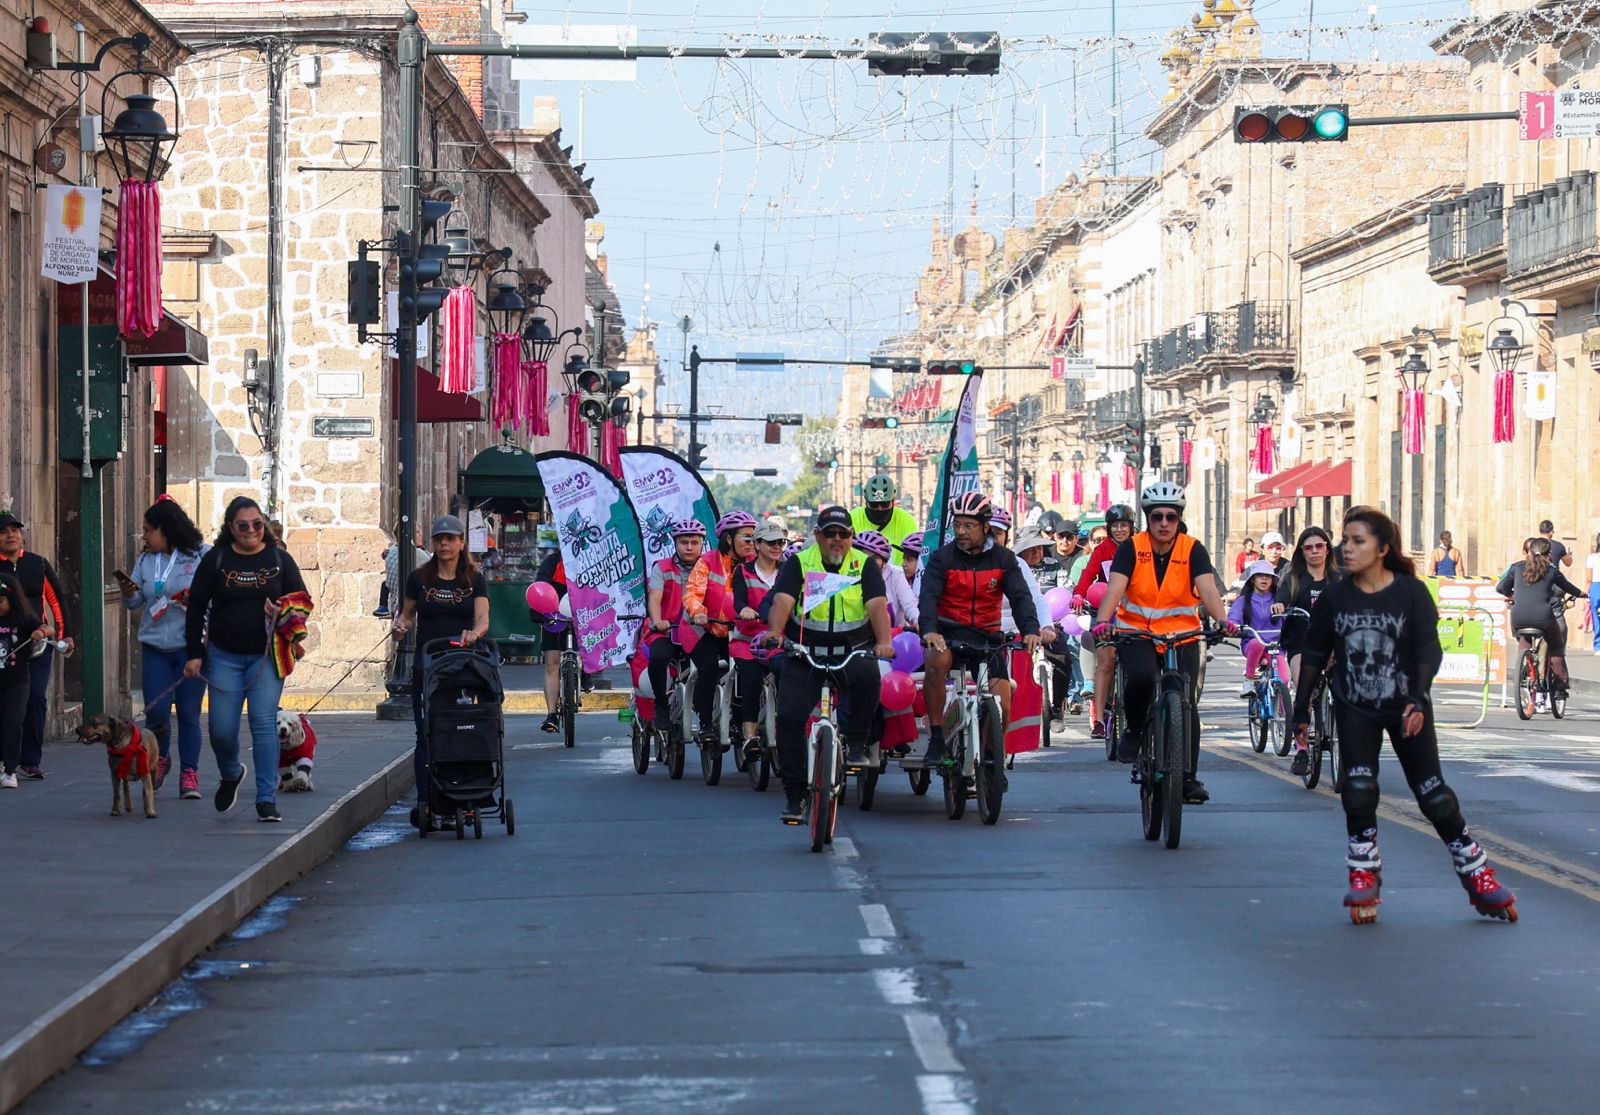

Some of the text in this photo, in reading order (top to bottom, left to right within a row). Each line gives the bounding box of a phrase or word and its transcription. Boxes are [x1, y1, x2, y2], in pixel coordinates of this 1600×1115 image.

[1520, 92, 1528, 139] SECTOR
[1534, 101, 1545, 129] 1
[55, 237, 86, 245] FESTIVAL
[44, 243, 97, 253] INTERNACIONAL
[60, 257, 90, 265] MORELIA
[44, 263, 75, 271] ALFONSO
